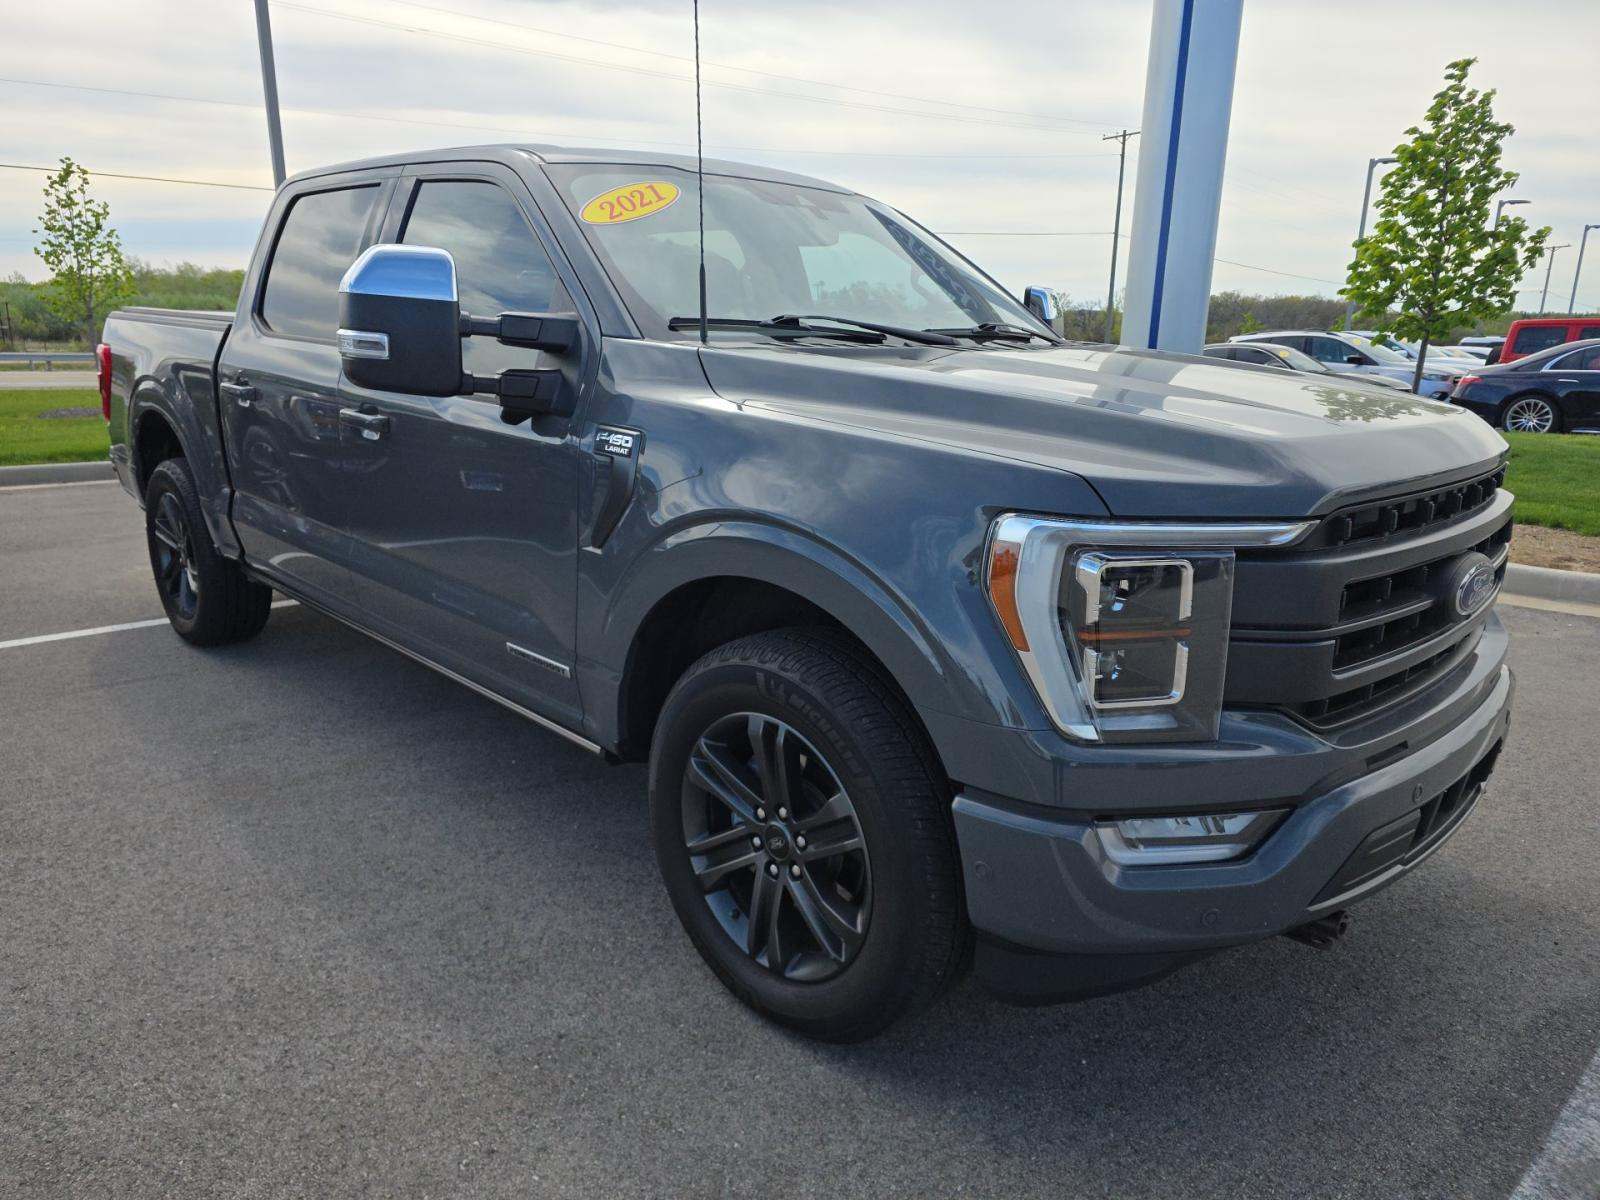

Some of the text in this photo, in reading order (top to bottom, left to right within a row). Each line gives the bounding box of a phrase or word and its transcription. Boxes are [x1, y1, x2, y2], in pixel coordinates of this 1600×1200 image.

[599, 183, 666, 220] 2021
[595, 432, 633, 448] F-150
[604, 444, 629, 455] LARIAT
